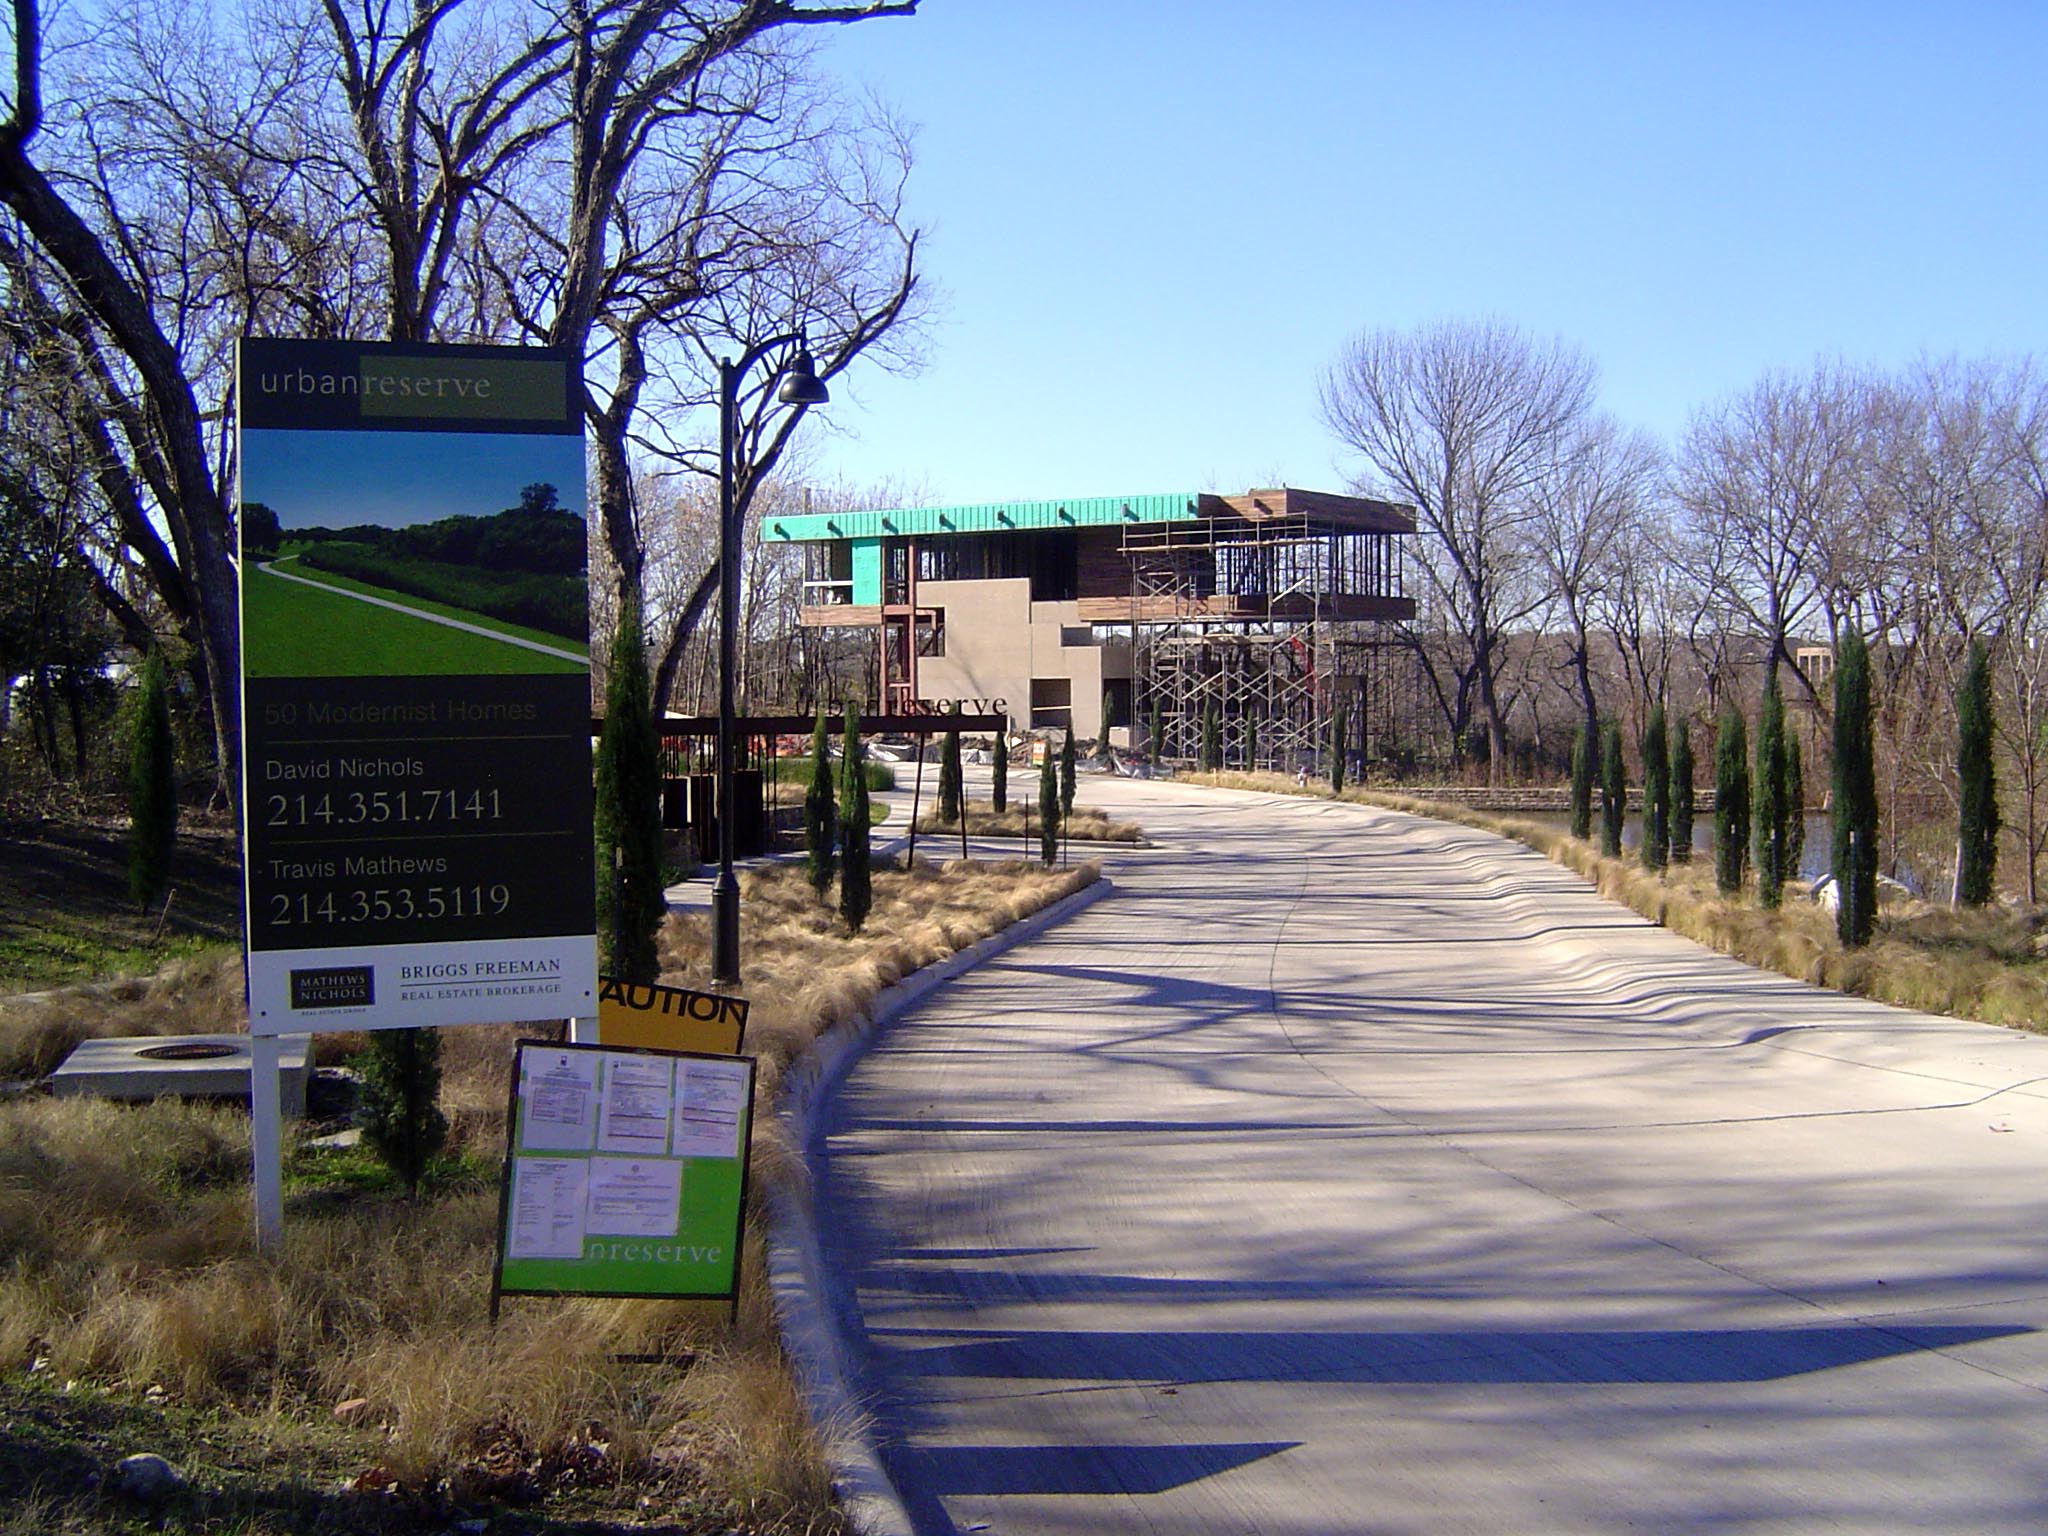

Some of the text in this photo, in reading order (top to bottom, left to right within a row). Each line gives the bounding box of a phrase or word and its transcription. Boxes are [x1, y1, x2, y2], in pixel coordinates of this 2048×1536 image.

[261, 368, 491, 398] urbanreserve
[264, 700, 537, 726] 50 Modernist Homes
[265, 758, 425, 780] David Nichols
[267, 788, 503, 826] 214.351.7141
[269, 856, 448, 880] Travis Mathews
[269, 884, 511, 926] 214.353.5119
[401, 958, 561, 980] BRIGGS FREEMAN
[300, 974, 366, 988] MATHEWS
[401, 983, 562, 1001] REAL ESTATE BROKERAGE
[301, 988, 367, 1001] NICHOLS
[600, 981, 747, 1023] AUTION
[588, 1243, 721, 1263] nreserve
